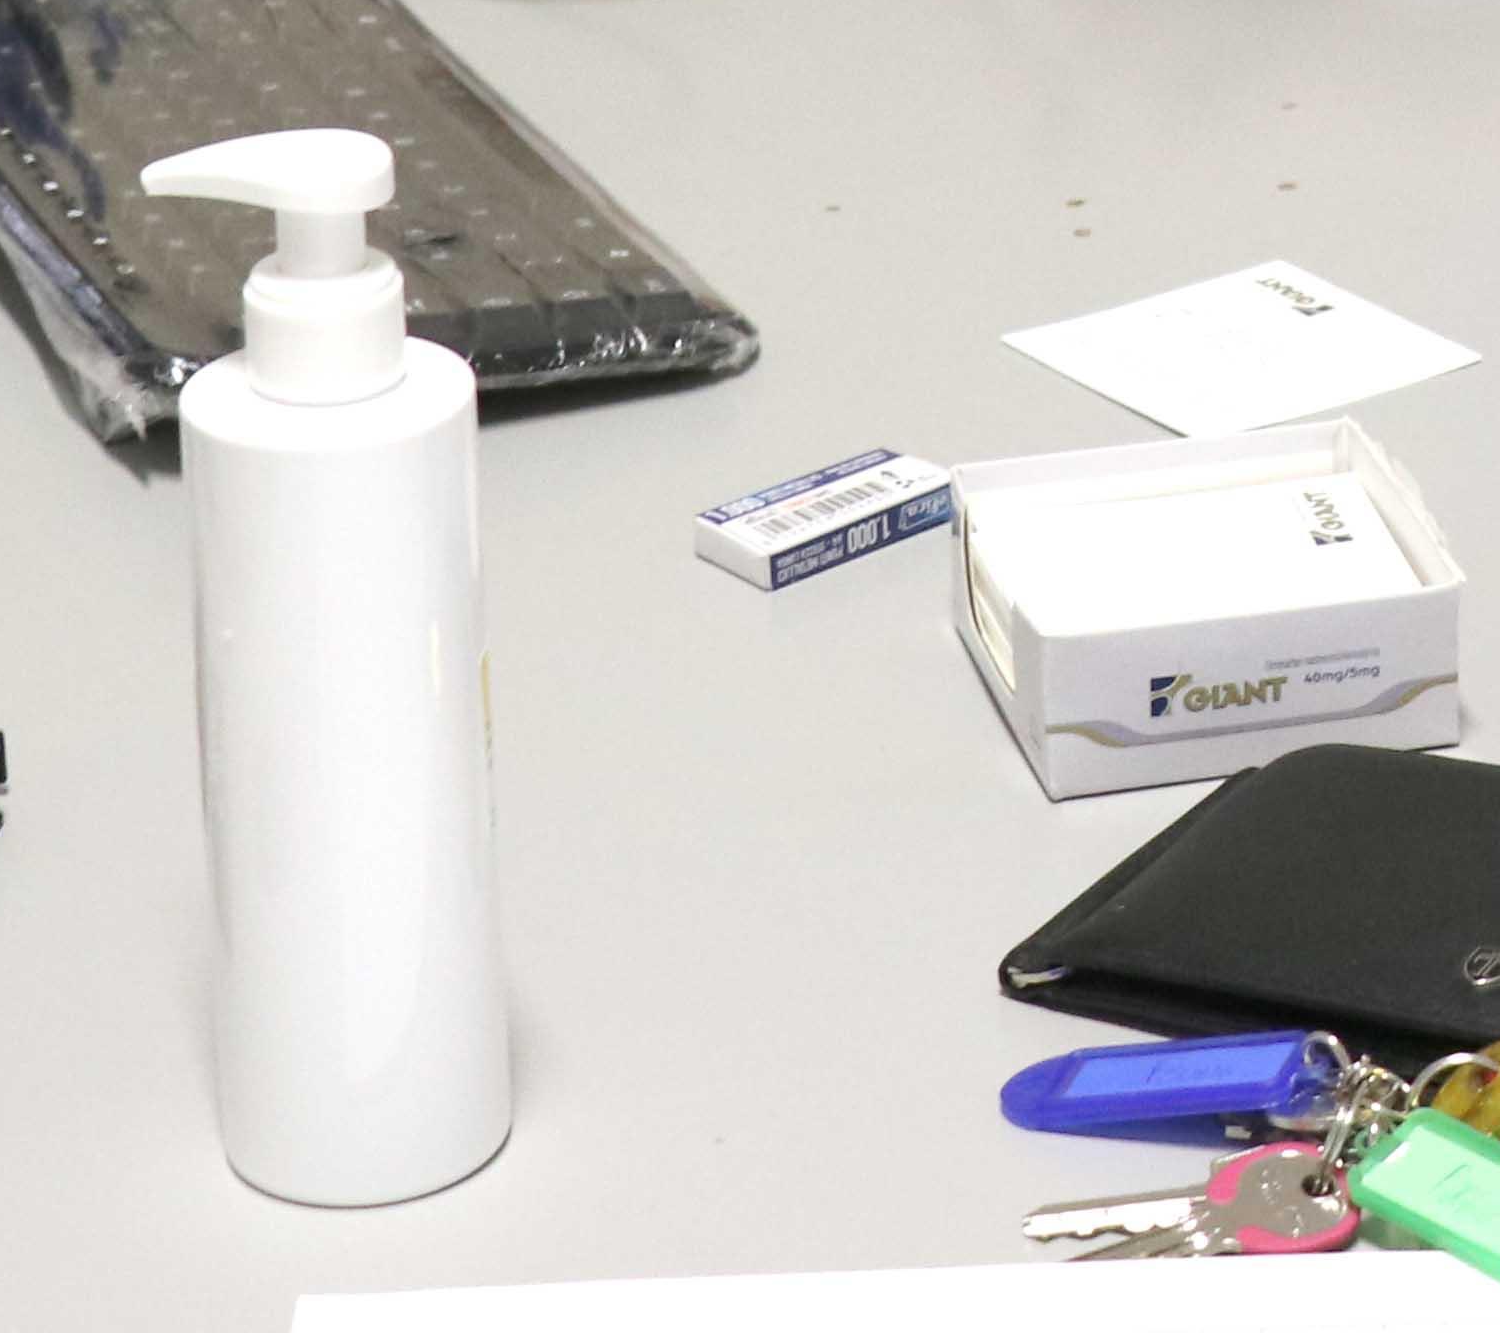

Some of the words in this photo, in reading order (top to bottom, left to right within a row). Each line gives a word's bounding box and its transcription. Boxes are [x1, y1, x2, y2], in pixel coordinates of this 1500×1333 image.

[847, 512, 892, 555] 1.000
[1183, 675, 1289, 713] GIANT
[1303, 663, 1381, 685] 40mg/5mg
